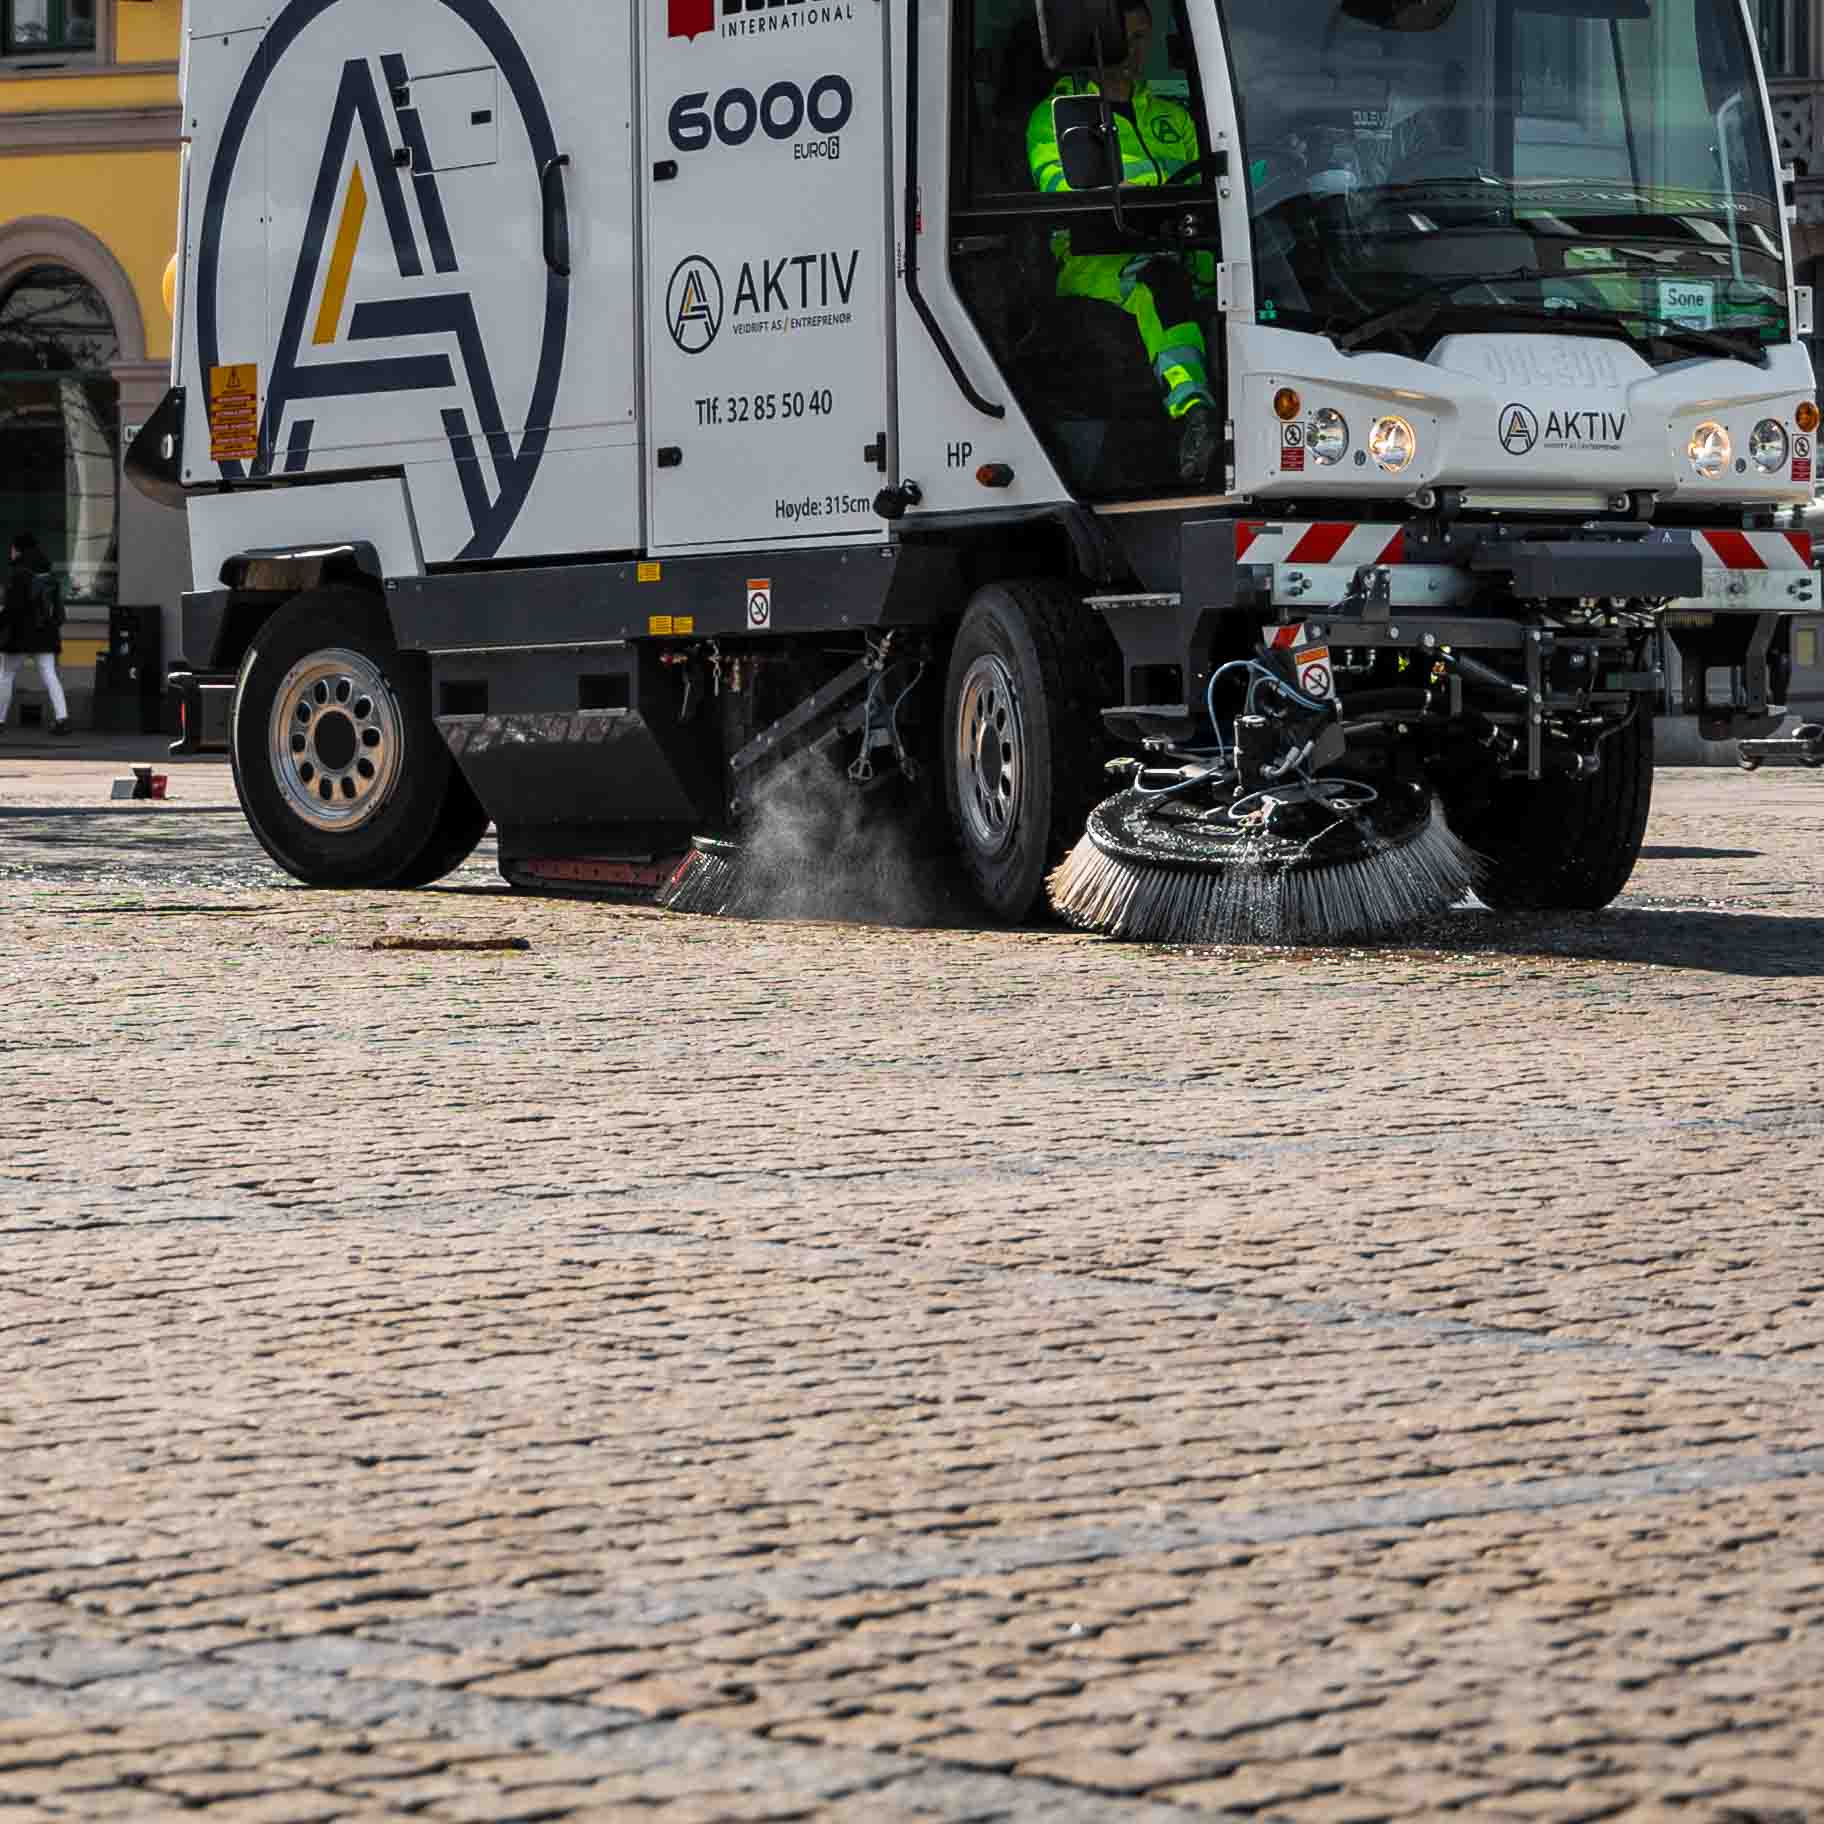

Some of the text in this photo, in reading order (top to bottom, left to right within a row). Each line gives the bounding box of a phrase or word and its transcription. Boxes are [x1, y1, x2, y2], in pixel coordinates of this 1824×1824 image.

[721, 4, 854, 39] INTERNATIONAL
[668, 74, 853, 152] 6000
[733, 249, 860, 316] AKTIV
[1667, 288, 1705, 307] Sone
[695, 389, 833, 425] Tlf. 32 85 50 40
[1544, 411, 1626, 441] AKTIV
[946, 441, 973, 468] HP
[775, 495, 871, 522] Høyde: 315cm
